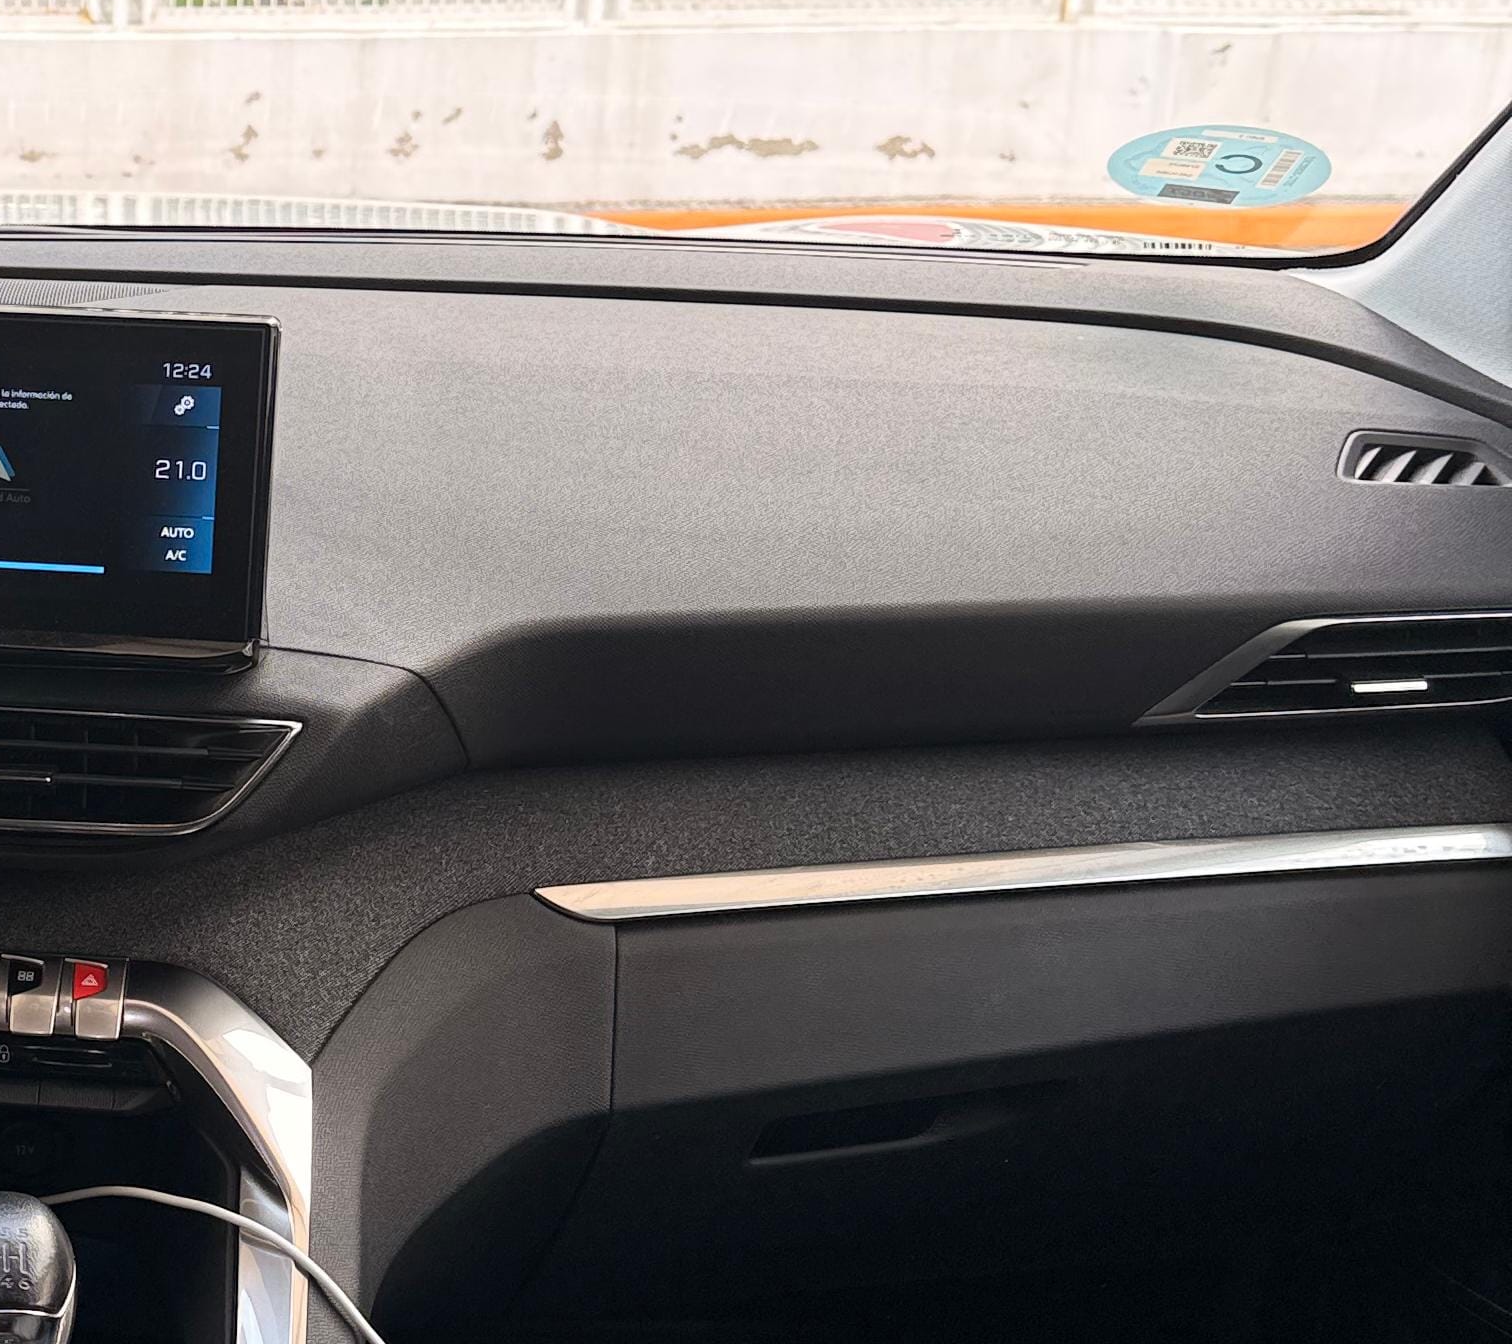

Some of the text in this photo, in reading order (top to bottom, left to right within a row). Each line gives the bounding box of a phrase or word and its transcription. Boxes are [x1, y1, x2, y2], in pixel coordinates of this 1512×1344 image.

[163, 362, 212, 379] 12:24
[2, 389, 10, 398] la
[11, 390, 61, 400] información
[62, 392, 72, 401] de
[154, 459, 207, 481] 21.0
[5, 493, 31, 504] Auto
[160, 526, 194, 539] AUTO
[165, 549, 187, 562] A/C
